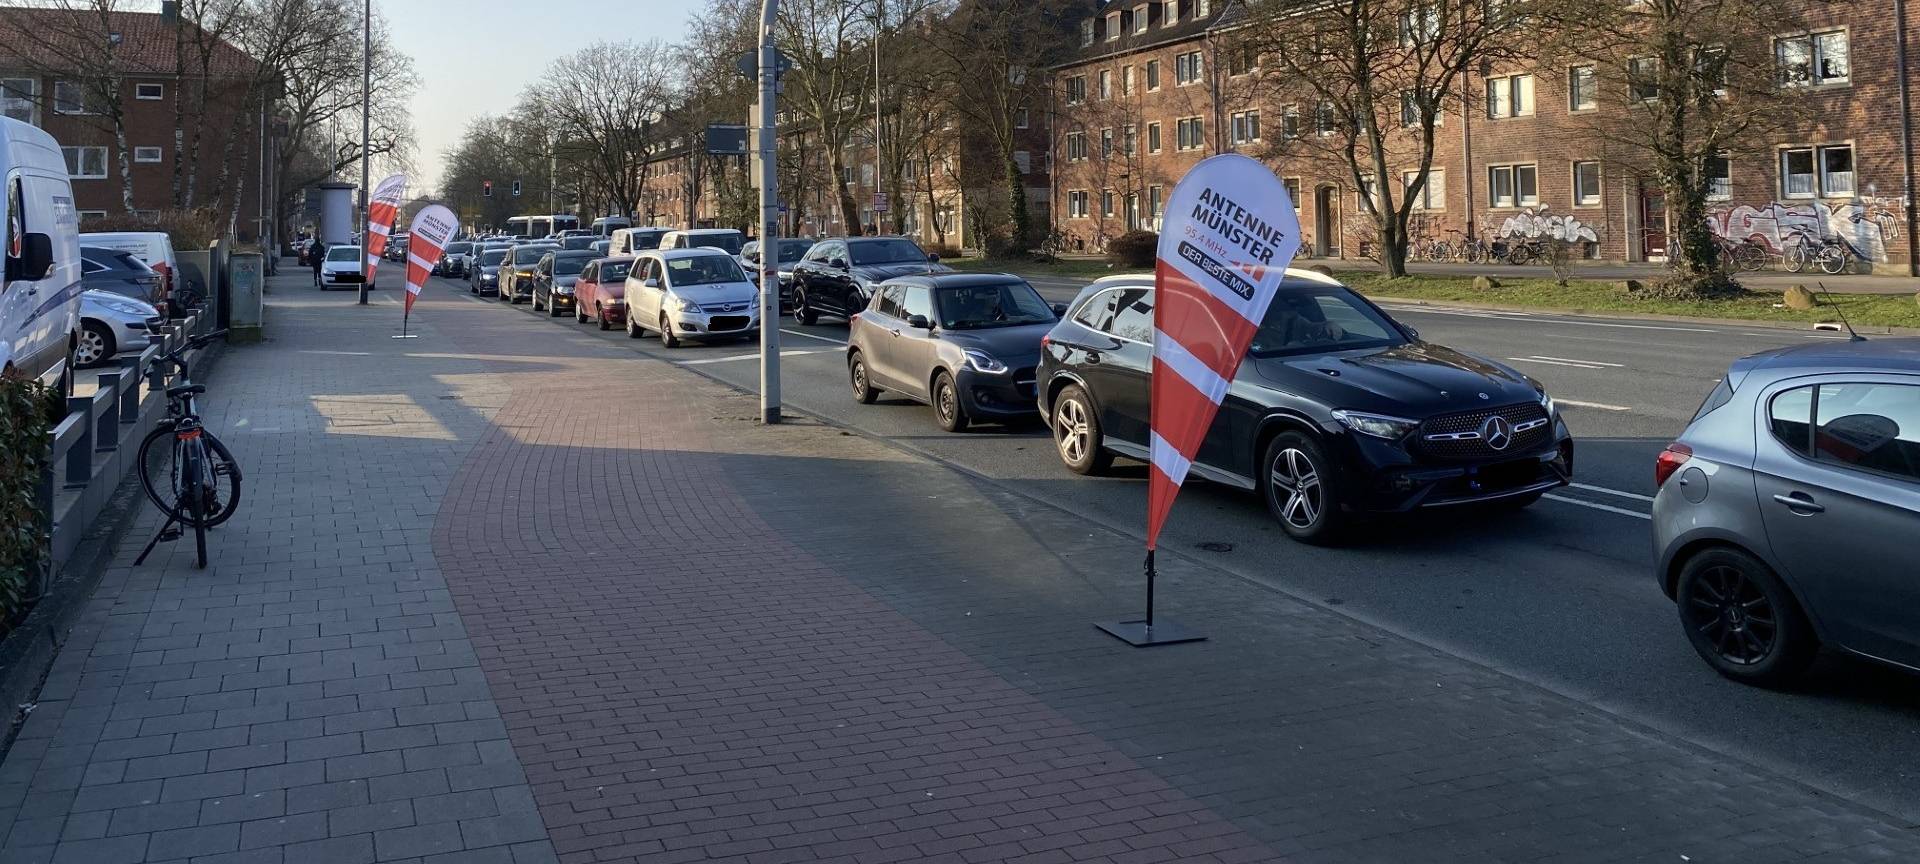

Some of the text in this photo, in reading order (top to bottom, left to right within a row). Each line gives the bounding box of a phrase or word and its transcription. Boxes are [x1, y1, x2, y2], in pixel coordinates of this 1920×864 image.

[1184, 225, 1228, 258] 95.4 MHz
[1191, 204, 1274, 266] MÜNSTER
[1199, 187, 1285, 249] ANTENNE
[1182, 245, 1250, 298] DER BESTE MIX.
